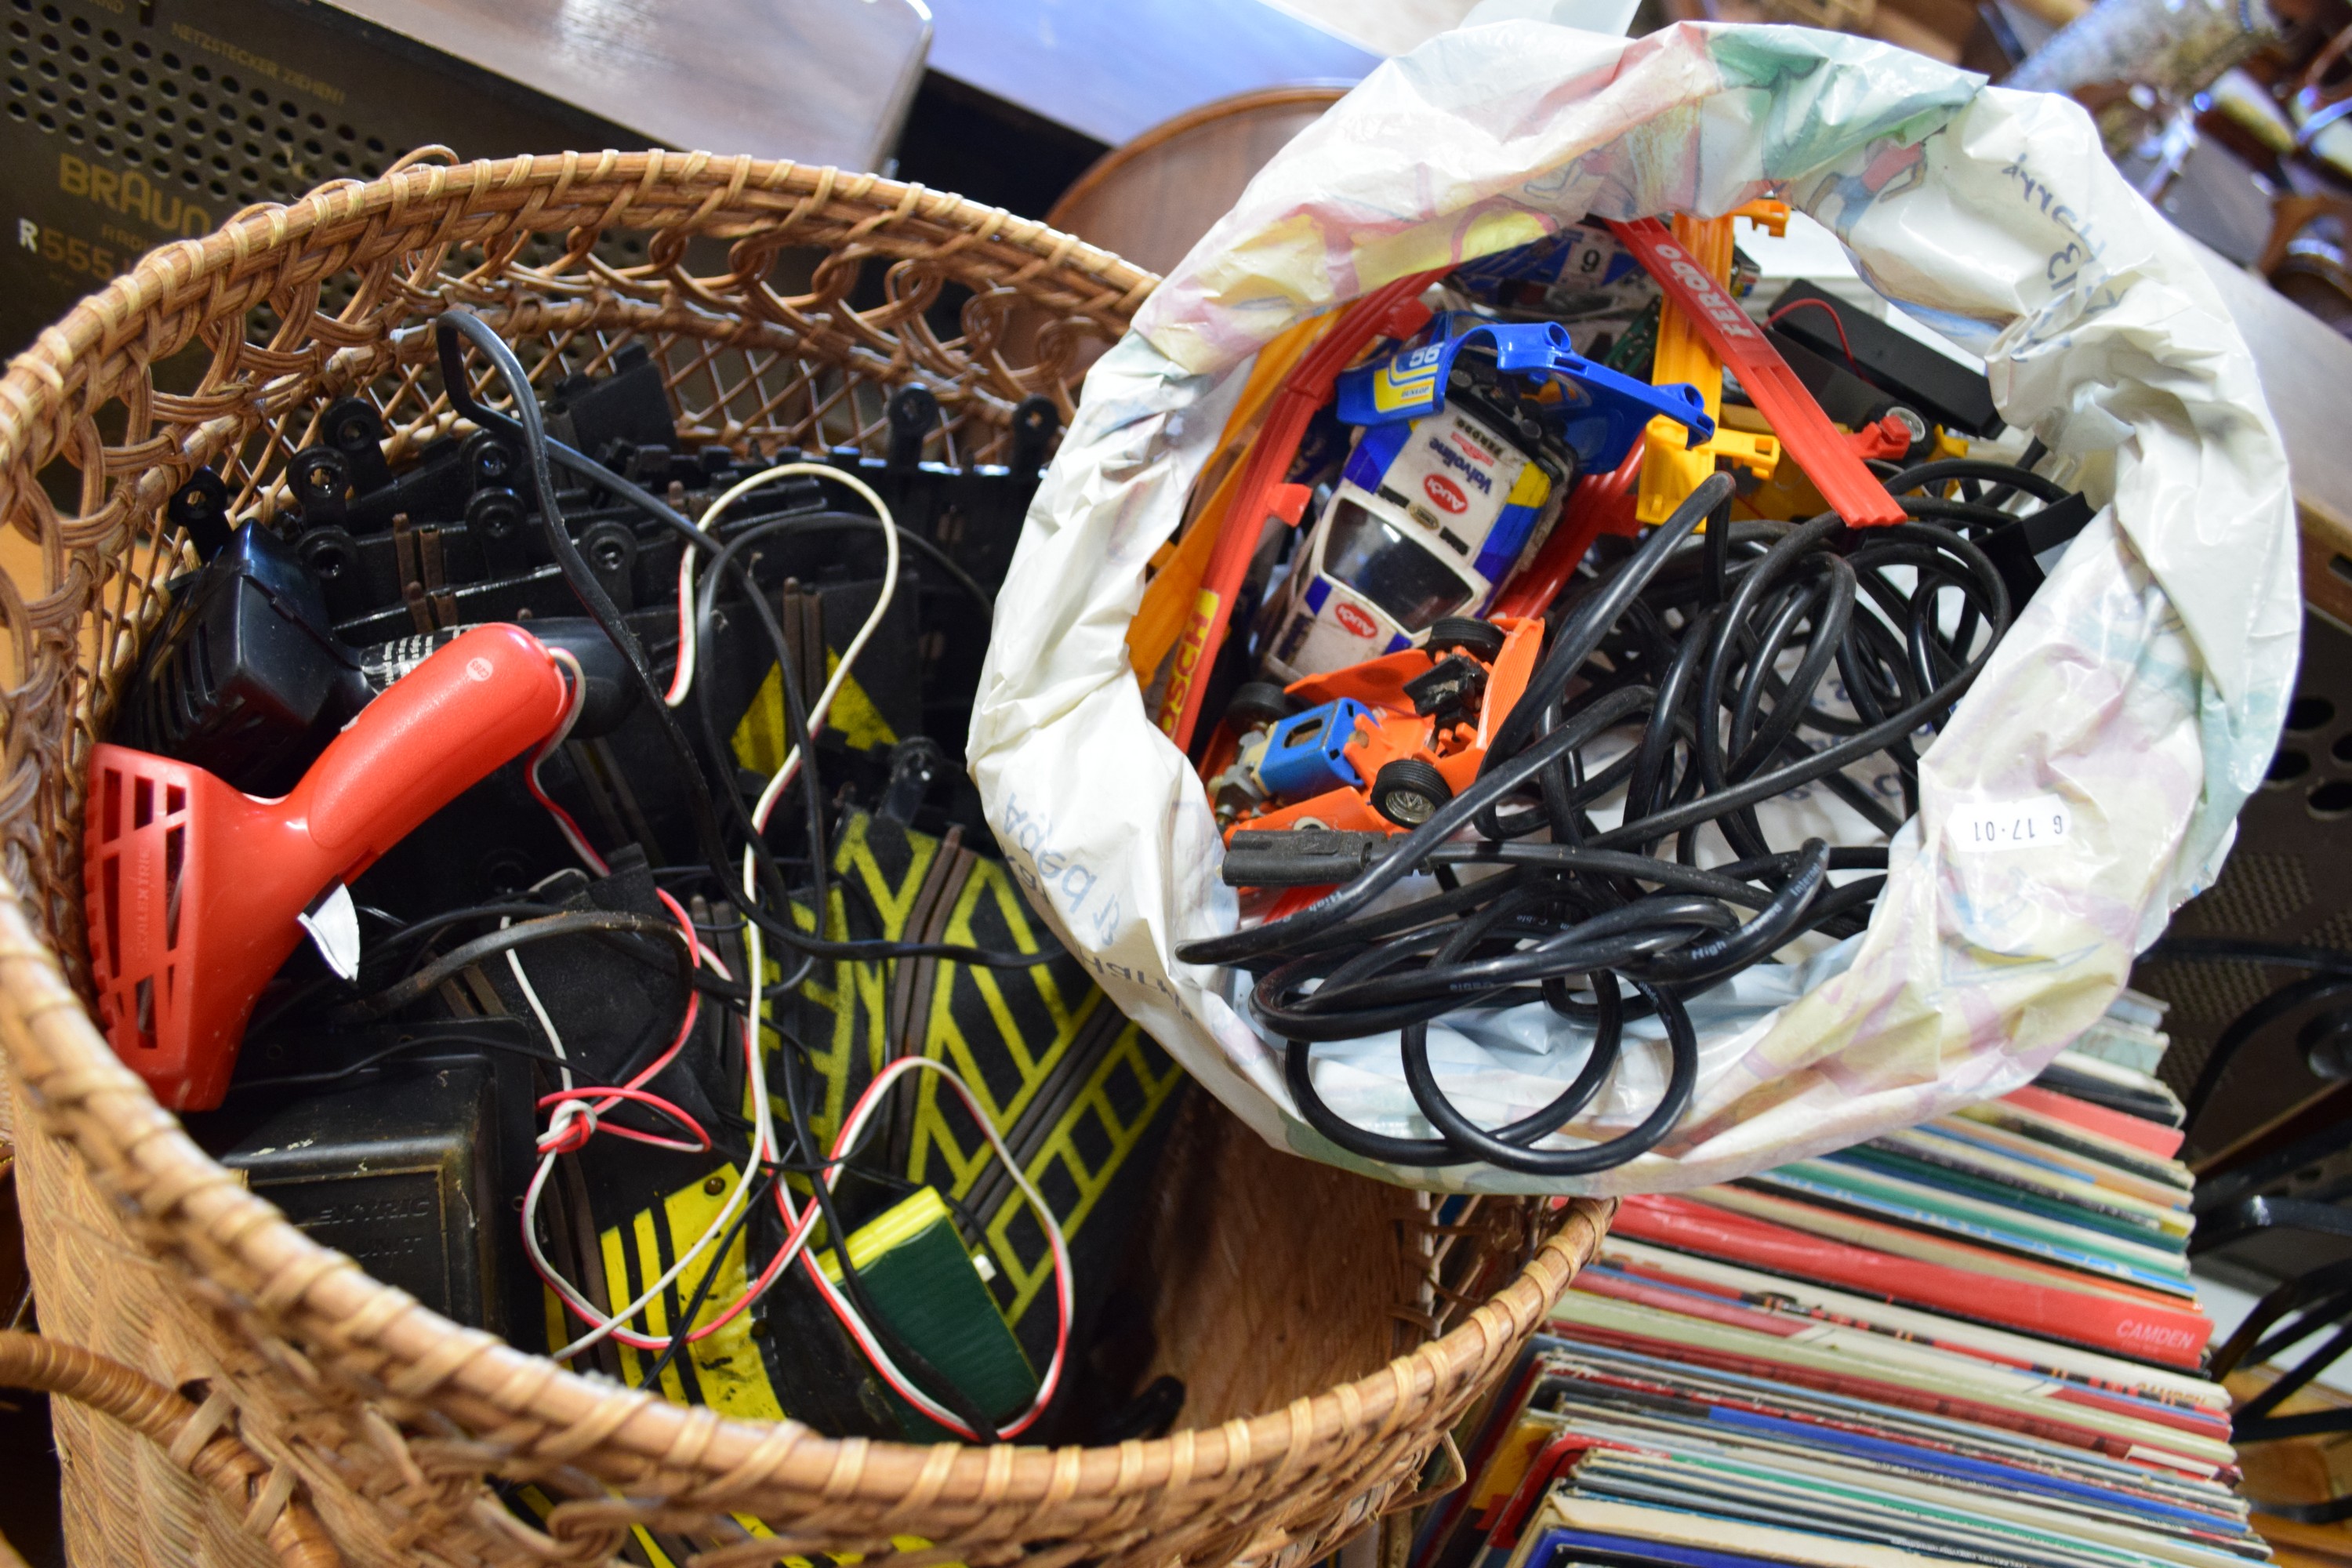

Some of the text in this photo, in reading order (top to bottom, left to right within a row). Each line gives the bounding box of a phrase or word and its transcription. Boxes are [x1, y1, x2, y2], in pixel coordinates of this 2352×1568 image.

[60, 152, 212, 236] BRAUN
[1655, 243, 1755, 339] FERODO
[1454, 417, 1506, 459] FERODO
[1429, 436, 1493, 495] Valvoline
[1427, 476, 1468, 512] Audi
[1338, 607, 1377, 637] Audi
[1158, 617, 1210, 739] OSCH
[1690, 939, 1727, 960] High
[2116, 1319, 2196, 1349] CAMDEN
